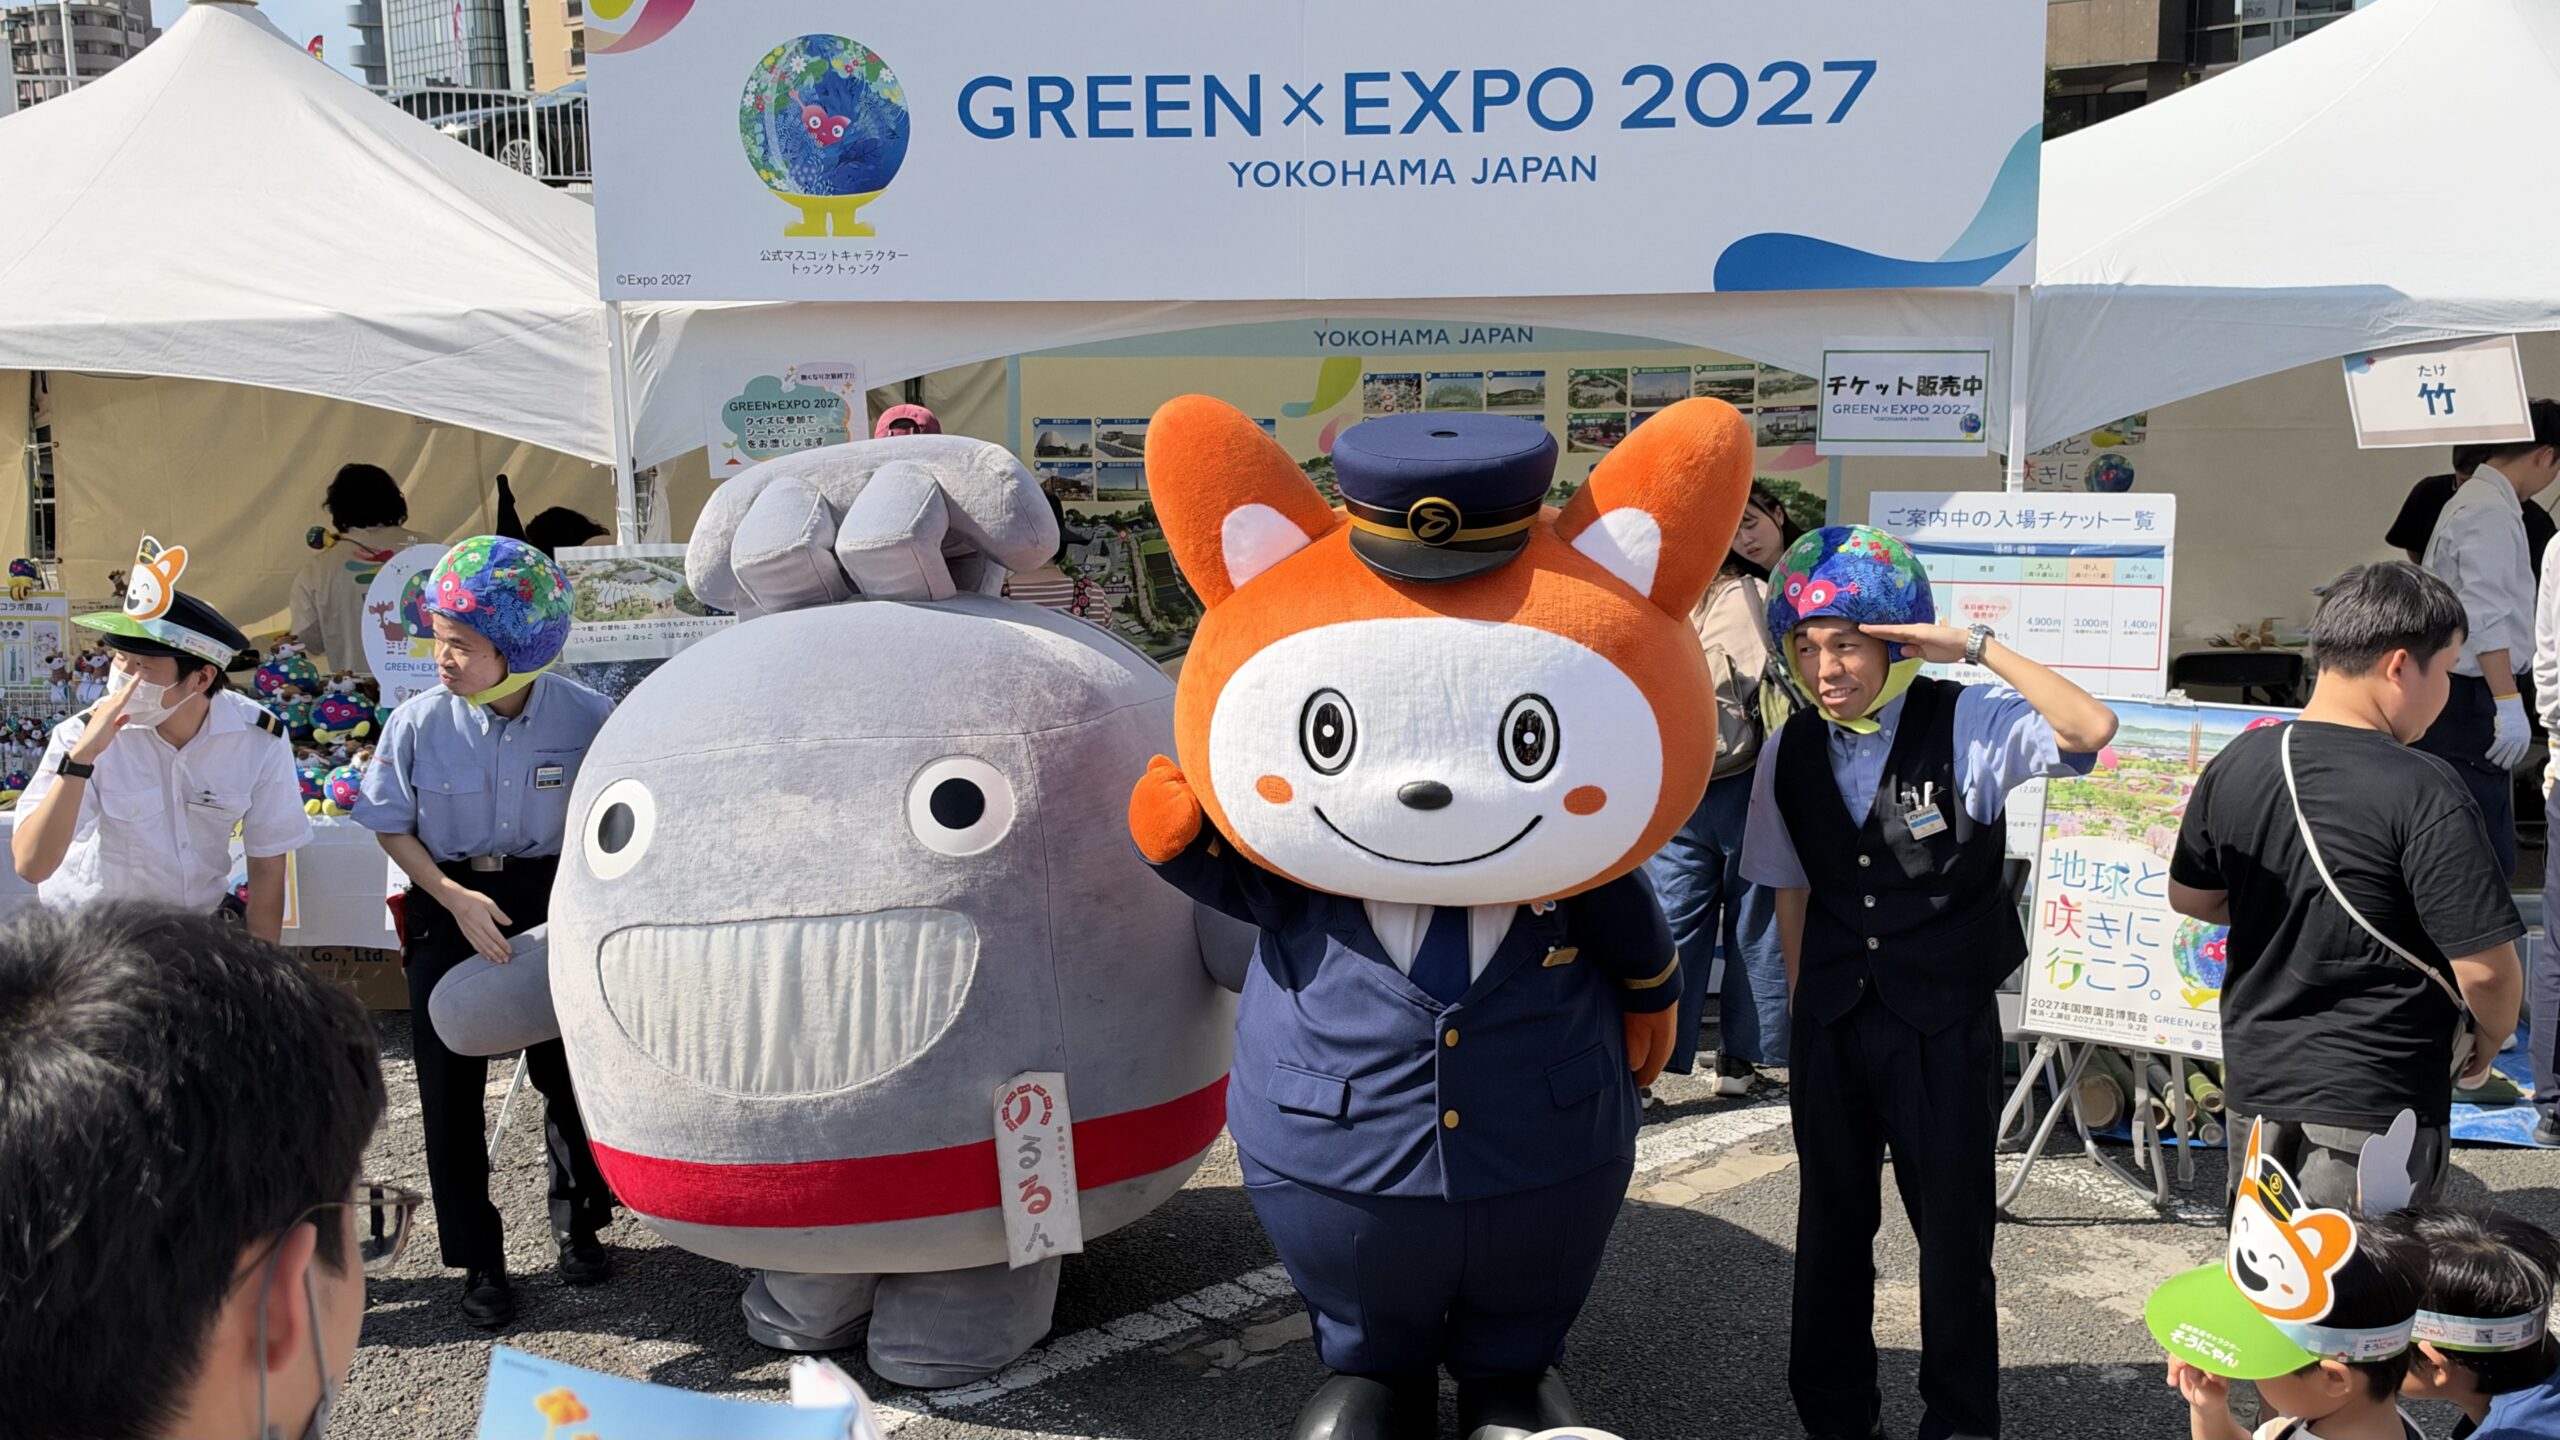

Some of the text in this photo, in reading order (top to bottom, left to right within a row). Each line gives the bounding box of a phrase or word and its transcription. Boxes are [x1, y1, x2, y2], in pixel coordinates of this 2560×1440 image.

[1620, 60, 1878, 131] 2027
[1228, 155, 1598, 188] YOKOHAMA JAPAN
[760, 250, 909, 262] 公式マスコットキャラクター
[792, 263, 880, 275] トゥンクトゥンク
[661, 274, 692, 286] 2027
[1314, 326, 1534, 347] YOKOHAMA JAPAN
[2417, 363, 2447, 378] たけ
[1826, 374, 1983, 397] チケット販売中
[814, 398, 840, 409] 2027
[1932, 404, 1971, 415] 2027
[2417, 382, 2456, 416] 竹
[745, 415, 816, 426] クイズに参加で
[747, 437, 824, 449] をお渡しします
[1887, 508, 2156, 531] ご案内中の入場チケット一覧
[2047, 849, 2166, 900] 地球と
[2043, 894, 2161, 949] 咲きに
[311, 947, 391, 967] Co., Ltd.
[2045, 947, 2161, 1000] 行こう。
[2170, 1328, 2236, 1368] そうにゃん
